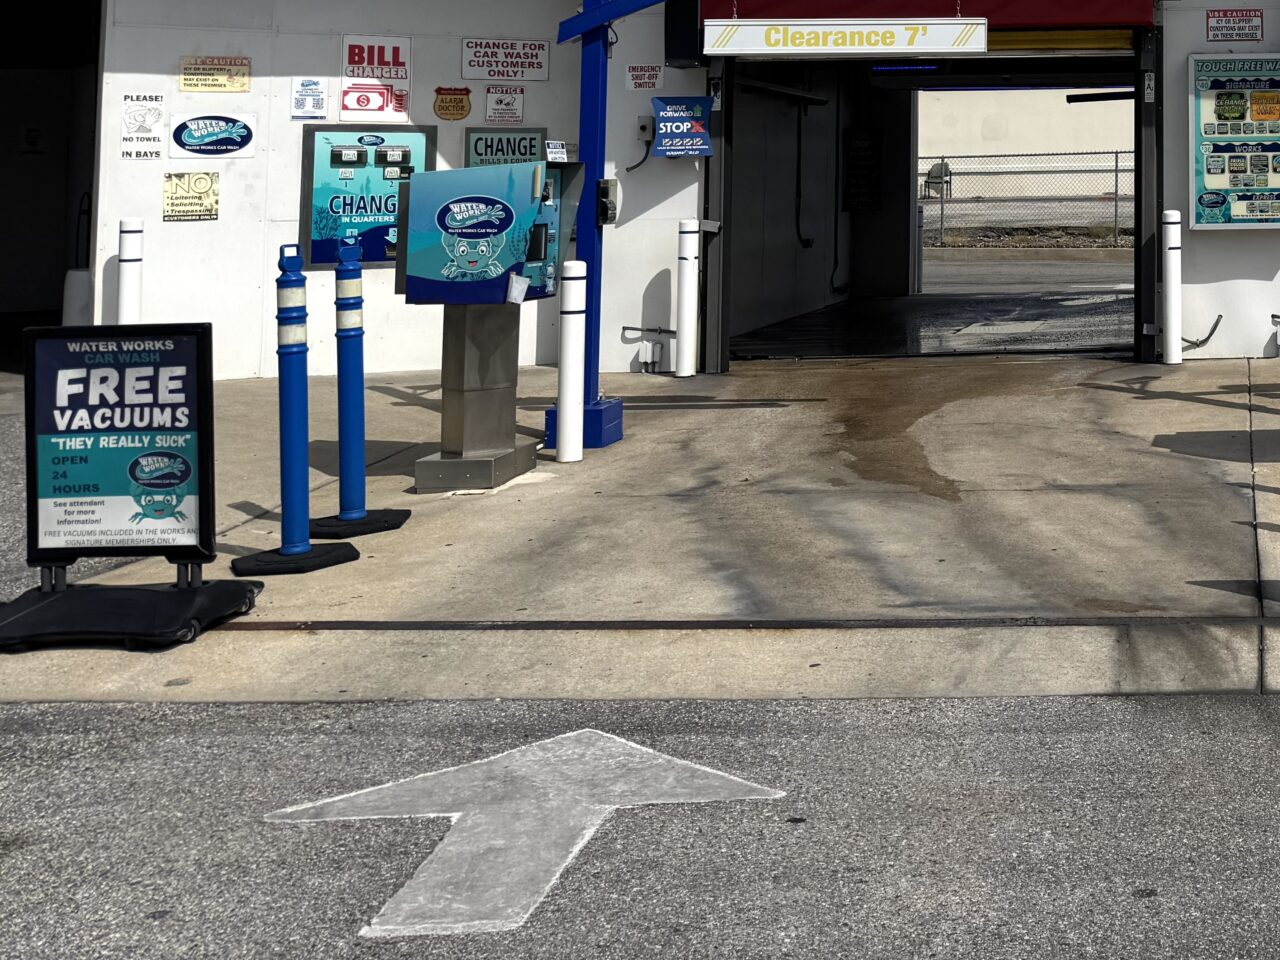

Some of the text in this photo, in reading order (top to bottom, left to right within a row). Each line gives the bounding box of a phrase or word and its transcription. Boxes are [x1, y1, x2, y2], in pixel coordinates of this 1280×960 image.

[764, 26, 928, 47] Clearance 7'
[466, 41, 545, 51] CHANGE FOR
[348, 44, 405, 67] BILL
[474, 50, 538, 60] CAR WASH
[468, 60, 543, 69] CUSTOMERS
[1196, 62, 1236, 72] TOUCH
[1238, 62, 1262, 71] FREE
[345, 66, 408, 79] CHANGER
[186, 120, 226, 130] WATER
[659, 122, 692, 133] STOP
[192, 126, 226, 138] WORKS
[474, 137, 536, 156] CHANGE
[171, 173, 212, 194] NO
[329, 194, 397, 215] CHANG
[448, 202, 486, 214] WATER
[454, 210, 486, 220] WORKS
[67, 340, 174, 352] WATER WORKS
[84, 352, 160, 364] CAR WASH
[56, 366, 187, 407] FREE
[54, 407, 190, 430] VACUUMS
[51, 434, 191, 450] "THEY REALLY SUCK"
[52, 456, 88, 466] OPEN
[138, 456, 169, 465] WATER
[52, 470, 68, 480] 24
[52, 484, 100, 494] HOURS
